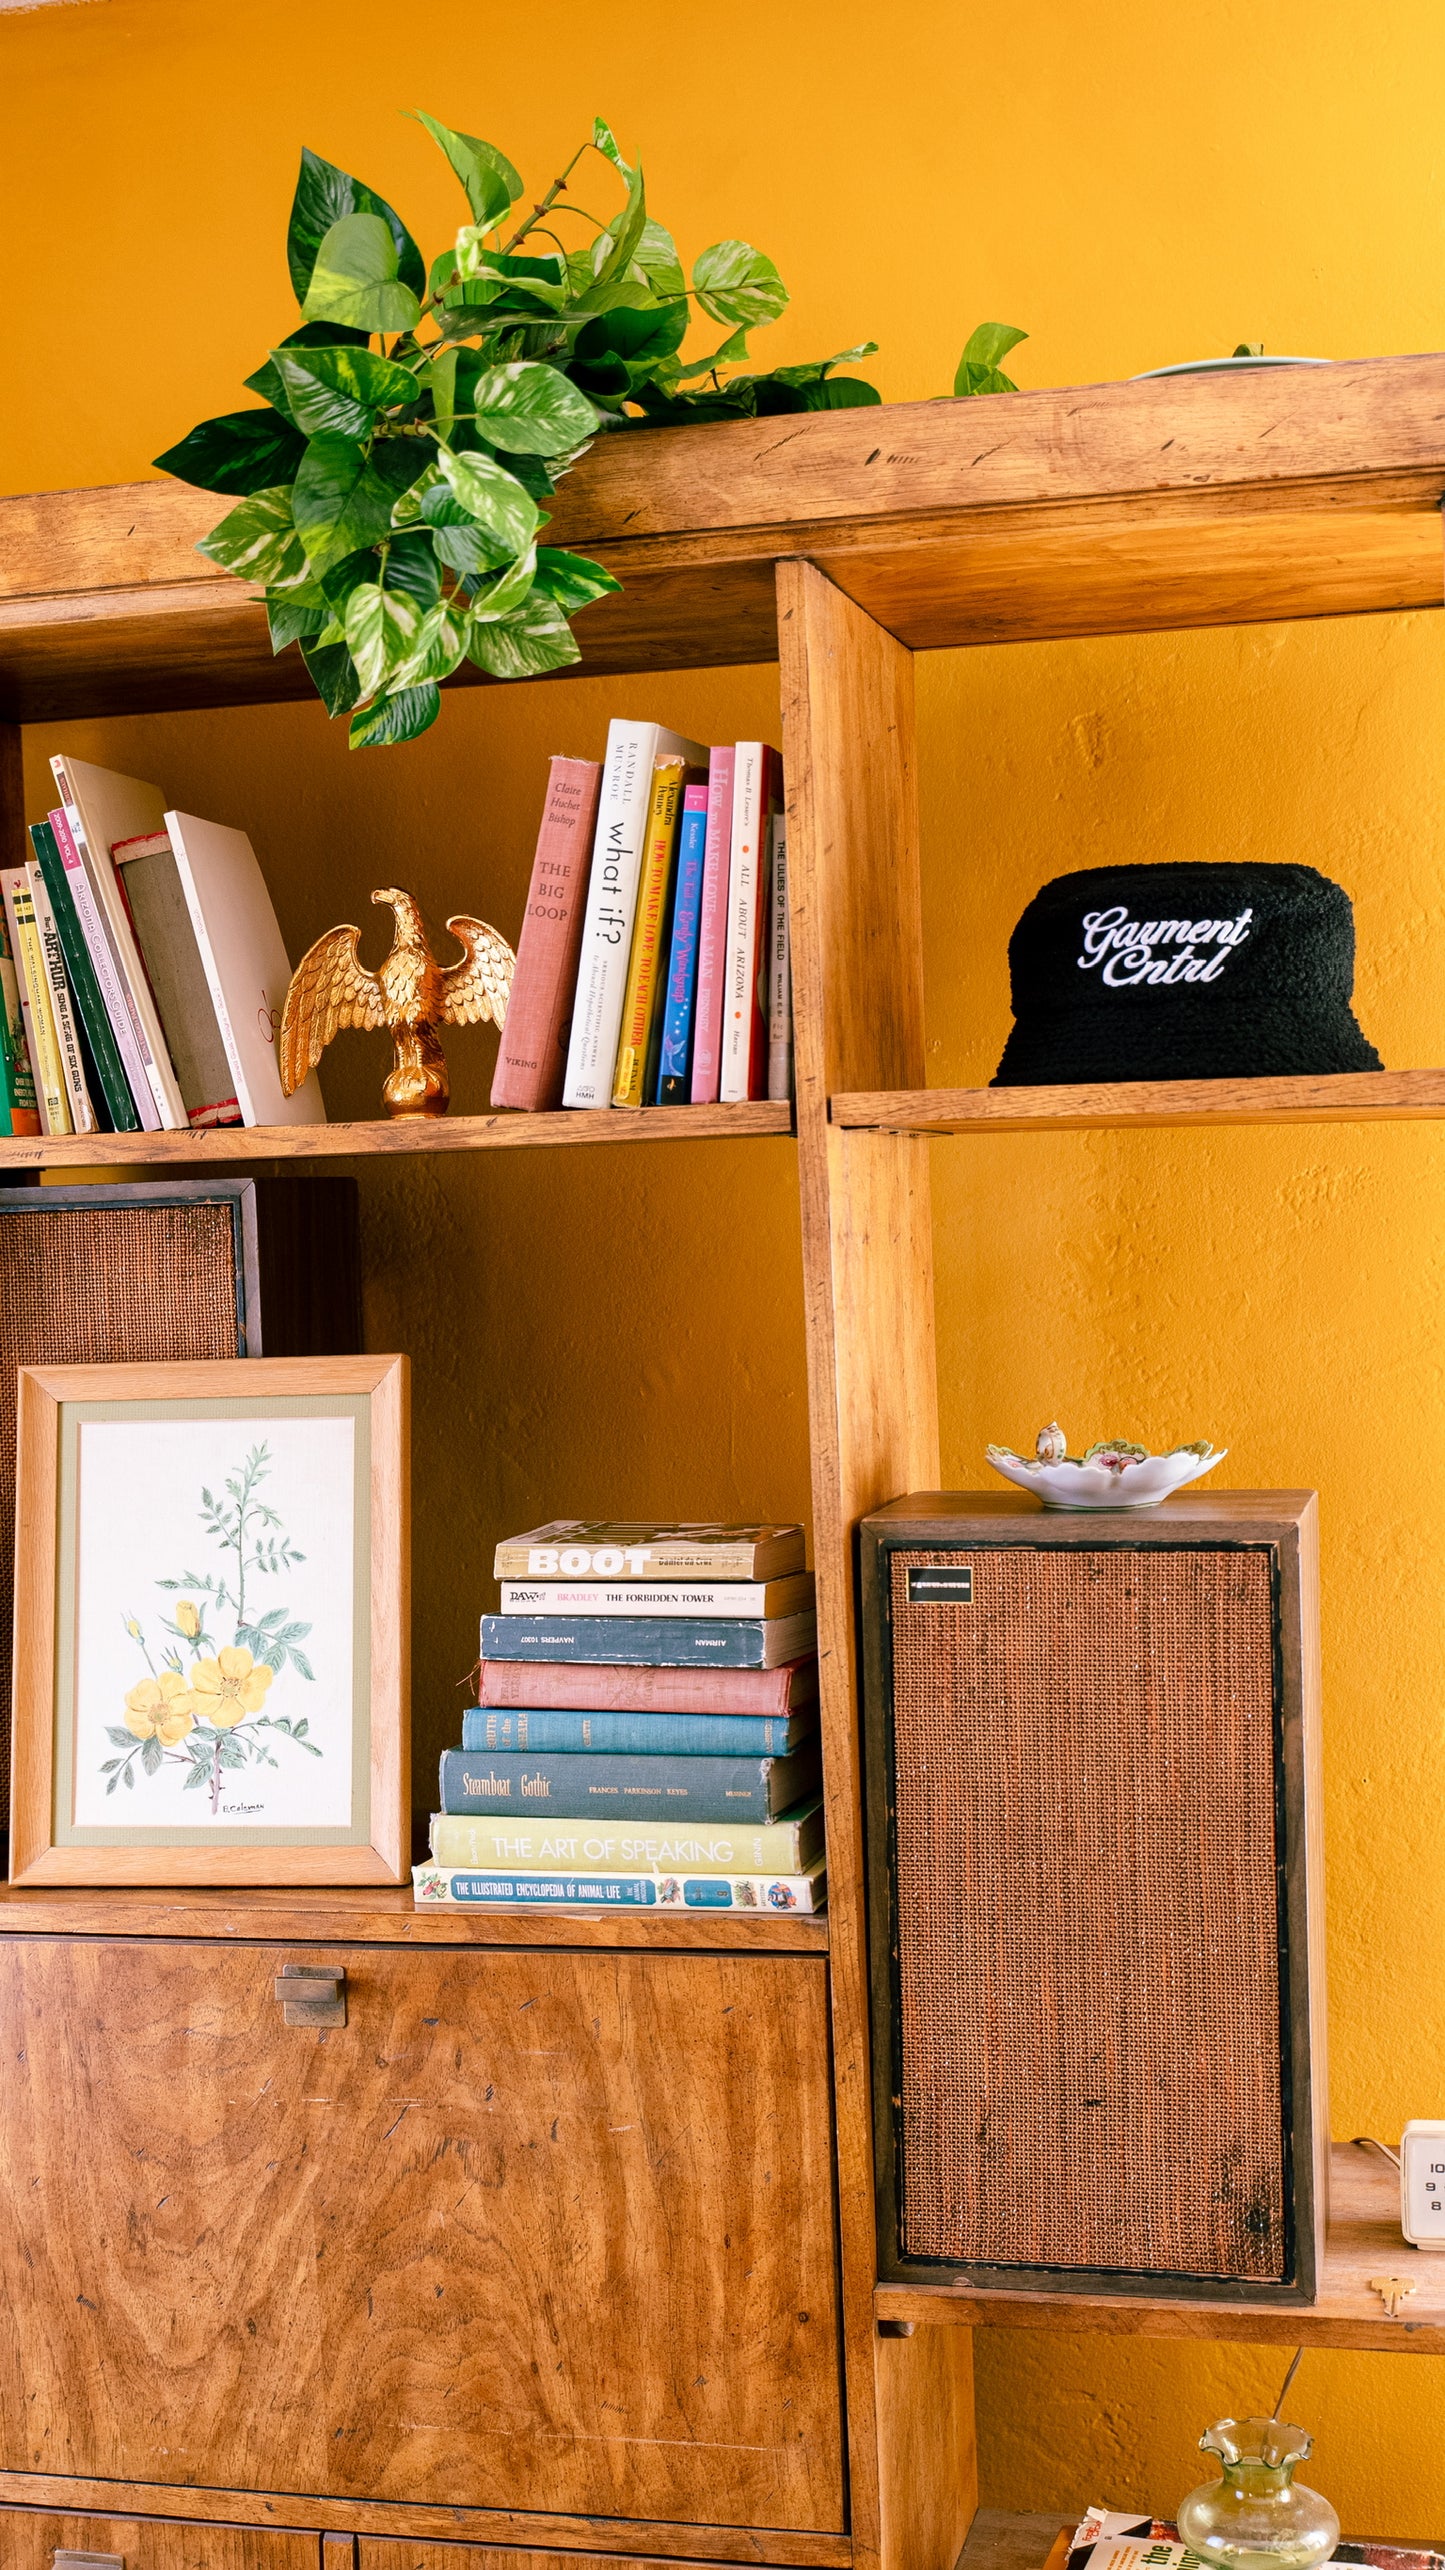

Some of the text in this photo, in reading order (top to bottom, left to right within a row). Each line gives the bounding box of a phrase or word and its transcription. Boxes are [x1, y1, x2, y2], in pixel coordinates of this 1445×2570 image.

[610, 744, 624, 800] MUNROE
[622, 742, 638, 804] RANDALL
[555, 782, 582, 796] Claire
[653, 785, 668, 816] Penney
[550, 797, 581, 811] Huchet
[664, 781, 678, 826] Alexandra
[54, 812, 68, 844] 2009-2010
[548, 812, 576, 828] Bishop
[688, 822, 699, 850] Kessler
[708, 828, 720, 870] MAKE
[540, 861, 572, 878] THE
[684, 861, 698, 878] The
[538, 883, 565, 899] BIG
[596, 822, 634, 944] what if?
[684, 882, 696, 900] Tail
[704, 875, 718, 913] LOVE
[528, 904, 568, 921] LOOP
[776, 841, 786, 961] THE LILIES OF THE FIELD
[674, 909, 696, 944] Emily
[703, 932, 714, 943] A
[734, 864, 750, 1000] ALL ABOUT ARIZONA
[1078, 905, 1252, 969] Garment
[630, 840, 666, 1046] HOW TO MAKE LOVE TO EACH OTHER
[44, 932, 66, 992] ARTHUR
[702, 945, 714, 979] MAN
[1102, 945, 1232, 988] Cntrl
[672, 944, 693, 1004] Windsnap
[57, 992, 68, 1015] SING
[38, 1008, 46, 1036] WOMAN
[62, 1021, 72, 1042] SONG
[66, 1044, 75, 1052] OF
[68, 1055, 78, 1070] SIX
[506, 1056, 538, 1070] VIKING
[72, 1070, 82, 1093] GUNS
[576, 1091, 595, 1100] HMH
[528, 1548, 651, 1575] BOOT
[658, 1557, 683, 1566] Daniel
[696, 1558, 712, 1566] Cruz
[557, 1593, 598, 1602] BRADLEY
[606, 1594, 624, 1602] THE
[626, 1594, 680, 1603] FORBIDDEN
[681, 1594, 714, 1603] TOWER
[695, 1639, 727, 1648] AIRMAN
[486, 1714, 497, 1750] SOUTH
[502, 1718, 511, 1747] of the
[462, 1771, 552, 1798] Steamboat Gothic
[588, 1786, 688, 1796] FRANCES PARKINSON KEYES
[492, 1837, 734, 1864] THE ART OF SPEAKING
[754, 1838, 762, 1866] GINN
[456, 1882, 621, 1899] THE ILLUSTRATED ENCYCLOPEDIA OF ANIMAL LIFE
[1430, 2164, 1445, 2174] 10
[1425, 2182, 1436, 2192] 9
[1431, 2202, 1442, 2210] 8
[1140, 2545, 1173, 2565] the
